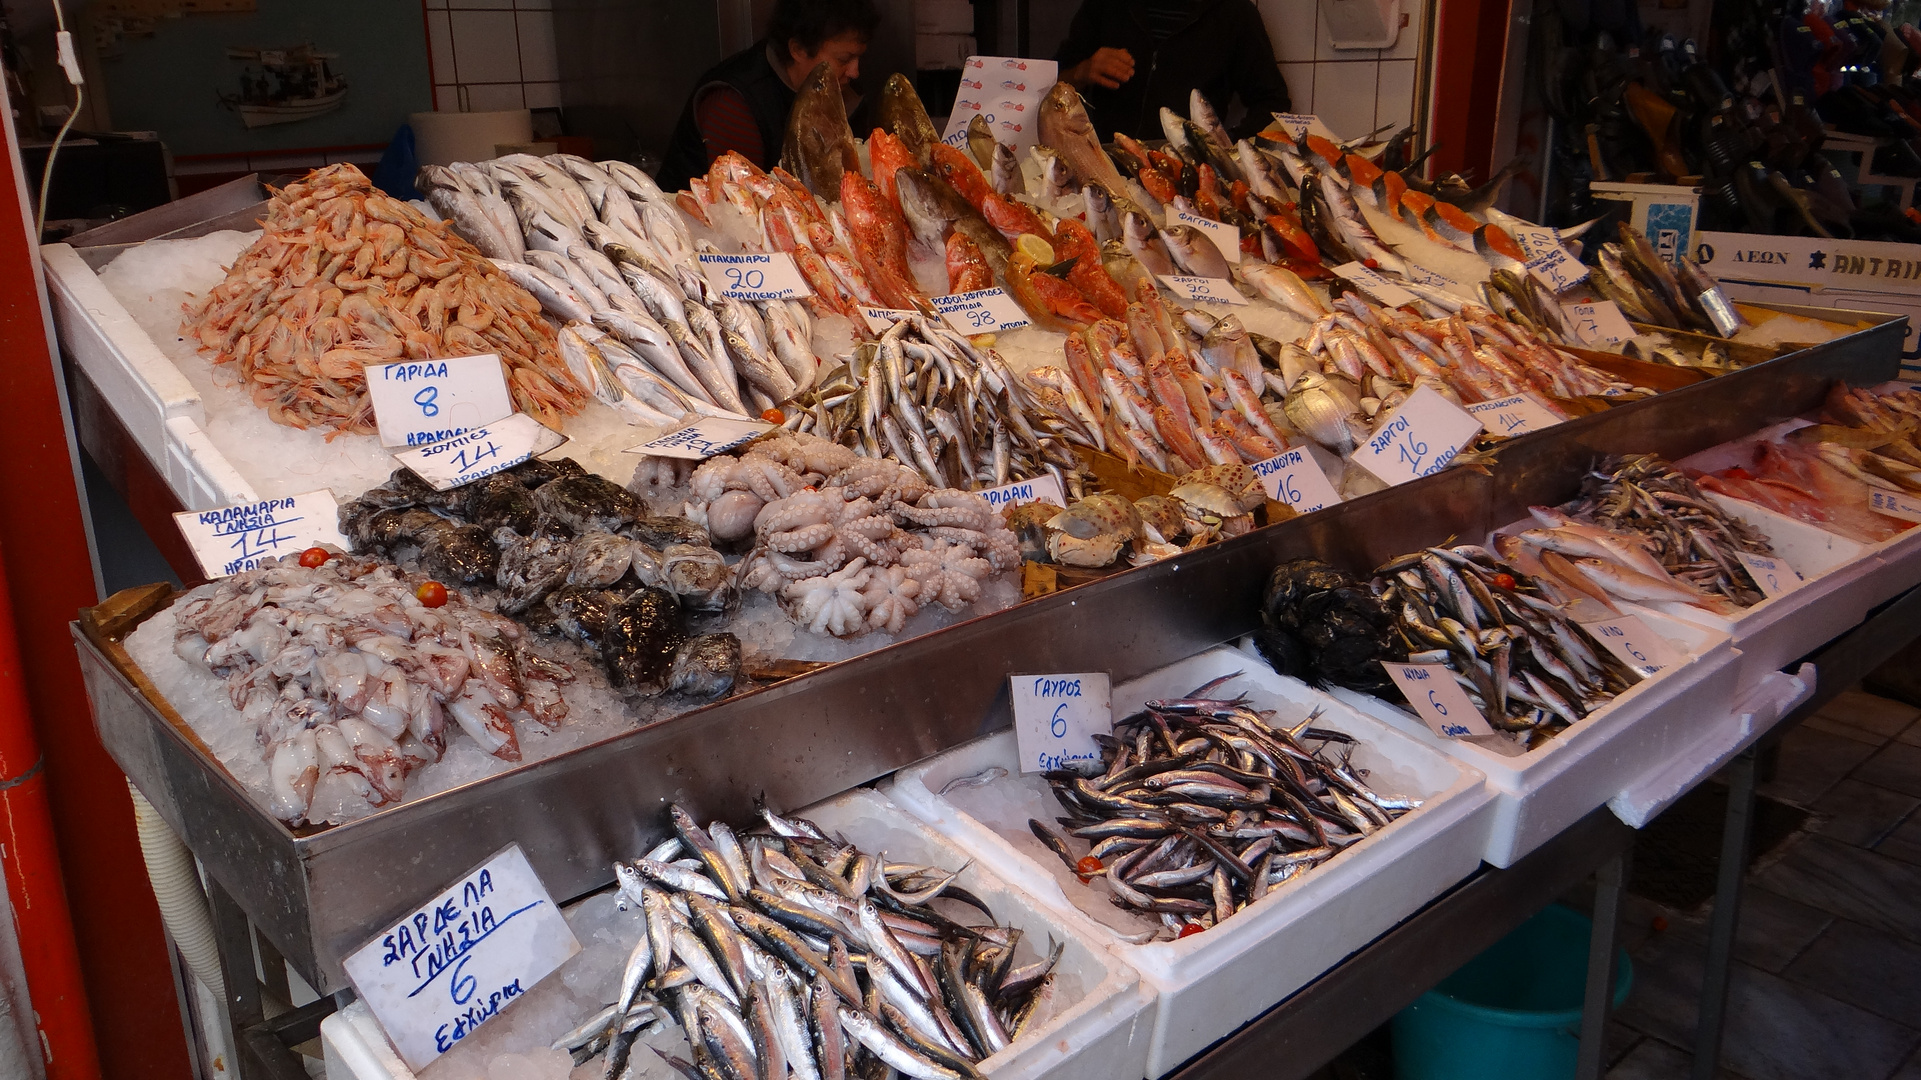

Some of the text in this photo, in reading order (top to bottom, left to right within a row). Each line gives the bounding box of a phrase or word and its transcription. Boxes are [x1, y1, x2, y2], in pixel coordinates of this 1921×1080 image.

[699, 254, 770, 264] ΜΠΑΚΑΛΙΑΡΟΙ
[1732, 249, 1790, 265] ΛΕΩΝ
[725, 267, 764, 289] 20
[1172, 276, 1210, 285] ΣΑΡΓΟΙ
[1185, 283, 1211, 294] 20
[966, 310, 996, 328] 28
[384, 362, 448, 382] ΓΑΡΙΔΑ
[413, 386, 439, 417] 8
[1370, 415, 1410, 455] ΣΑΡΓΟΙ
[450, 441, 503, 474] 14
[1399, 431, 1428, 473] 16
[1276, 474, 1302, 506] 16
[199, 497, 296, 525] ΚΑΛΑΜΑΡΙΑ
[230, 528, 296, 562] 14
[1624, 642, 1646, 661] 6
[1033, 677, 1082, 698] ΓΑΥΡΟΣ
[1428, 689, 1448, 716] 6
[1051, 702, 1068, 739] 6
[382, 868, 494, 967] ΣΑΡΔΕΛΑ
[411, 905, 498, 979] ΓΝΗΣΙΑ
[450, 954, 477, 1006] 6
